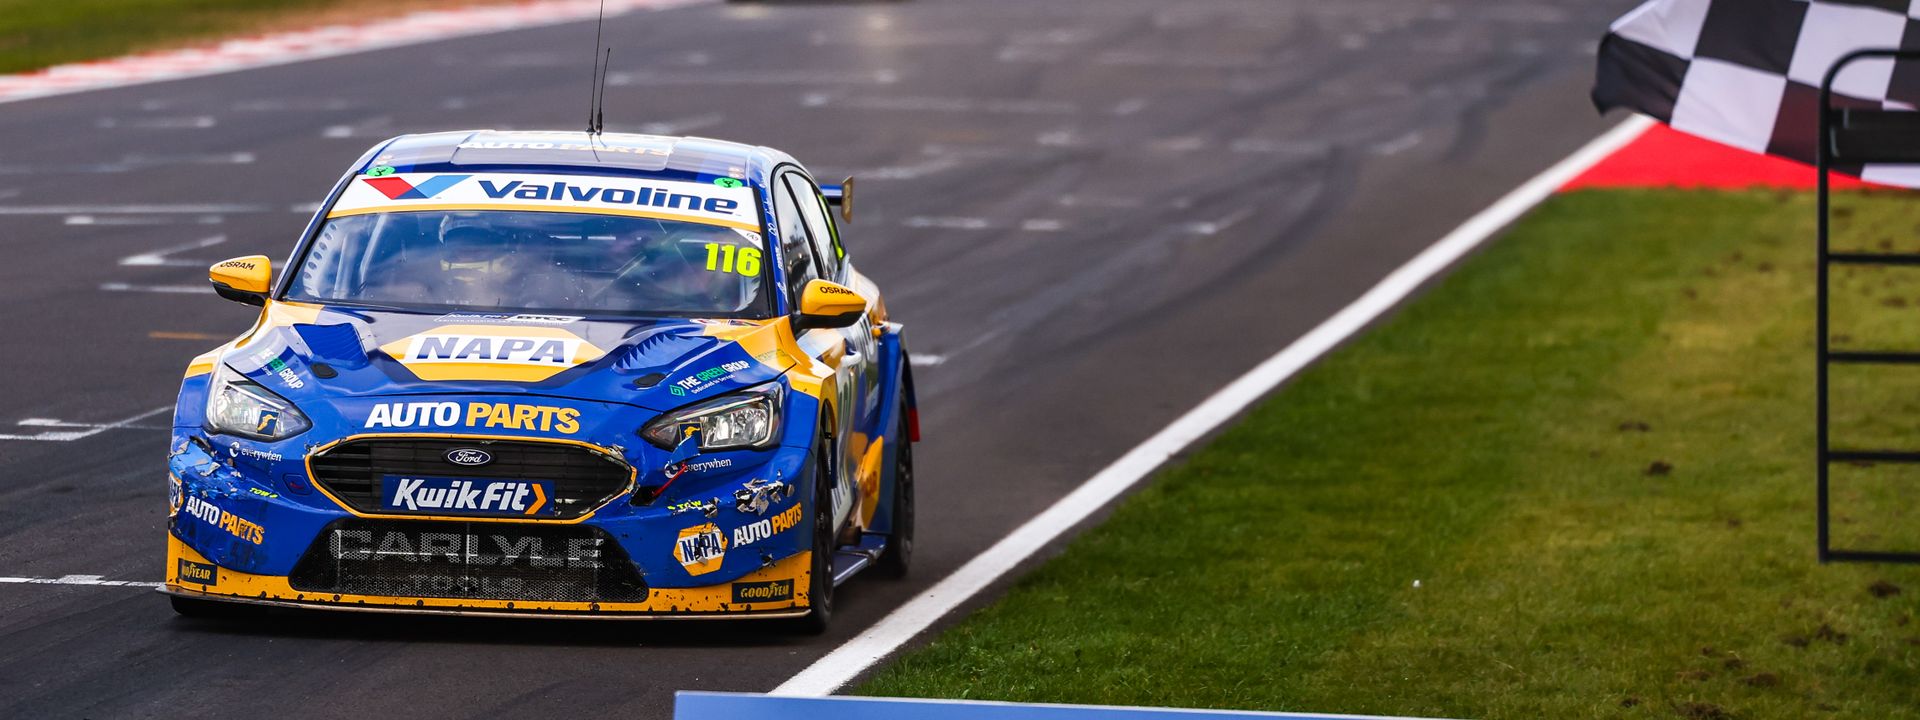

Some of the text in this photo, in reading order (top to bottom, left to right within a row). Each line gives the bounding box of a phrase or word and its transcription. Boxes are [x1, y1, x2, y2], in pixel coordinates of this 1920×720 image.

[478, 180, 738, 215] Valvoline
[220, 261, 255, 271] OSRAM
[705, 242, 761, 276] 116
[820, 286, 855, 297] OSRAM
[416, 337, 565, 363] NAPA
[279, 367, 304, 389] GROUP
[677, 360, 750, 389] THE GREEN GROUP
[364, 402, 581, 434] AUTO PARTS
[455, 451, 482, 463] Ford
[185, 496, 265, 545] AUTO PARTS
[733, 502, 803, 549] AUTO PARTS
[329, 529, 605, 569] CARLYLE
[680, 532, 723, 563] NAPA
